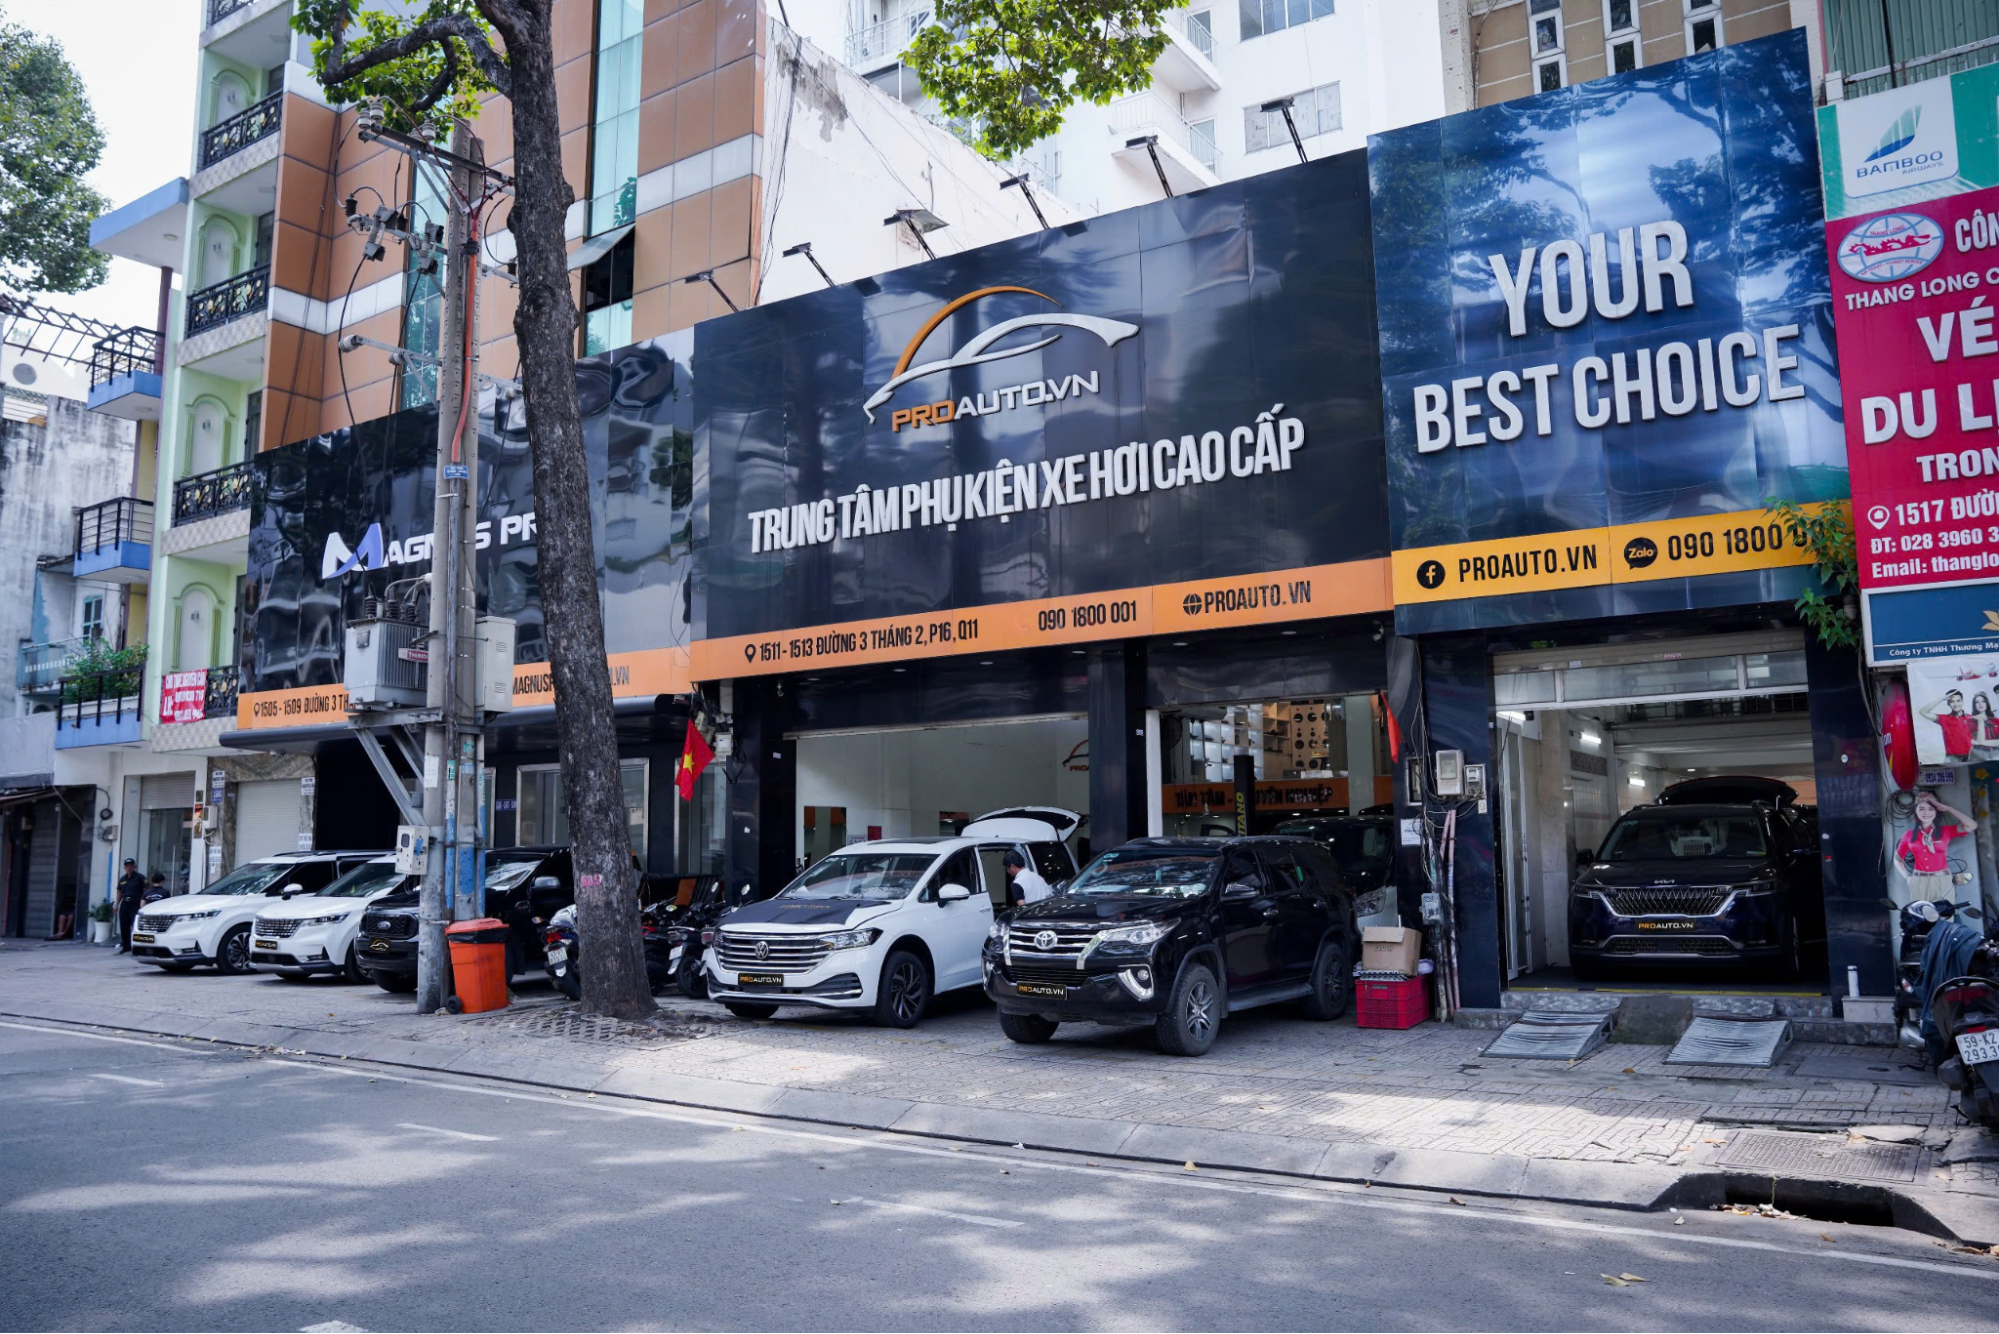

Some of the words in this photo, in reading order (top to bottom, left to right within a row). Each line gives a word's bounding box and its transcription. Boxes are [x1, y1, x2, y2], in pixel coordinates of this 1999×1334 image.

[1856, 150, 1943, 179] BAMBOO
[1902, 161, 1944, 175] AIRWAYS
[1488, 219, 1694, 338] YOUR
[1845, 284, 1914, 310] THANG
[1921, 271, 1980, 298] LONG
[1916, 295, 1998, 363] VÉ
[891, 370, 1099, 433] PROAUTO.VN
[1413, 363, 1559, 454] BEST
[1571, 323, 1806, 429] CHOICE
[1860, 388, 1938, 445] DU
[748, 498, 835, 554] TRUNG
[837, 483, 900, 539] TÂM
[902, 475, 962, 532] PHỤ
[964, 458, 1038, 523] KIỆN
[1040, 453, 1088, 509] XE
[1089, 441, 1150, 500] HƠI
[1152, 430, 1226, 490] CAO
[1229, 402, 1305, 478] CẤP
[1895, 499, 1945, 526] 1517
[1458, 544, 1598, 583] PROAUTO.VN
[1628, 545, 1655, 559] Zalo
[1667, 531, 1715, 562] 090
[1723, 523, 1783, 556] 1800
[1870, 537, 1897, 554] ĐT:
[1901, 532, 1934, 552] 028
[1938, 528, 1983, 548] 3960
[1871, 557, 1928, 579] Email:
[1038, 608, 1066, 631] 090
[1072, 603, 1107, 628] 1800
[1110, 600, 1137, 624] 001
[1204, 580, 1311, 613] PROAUTO.VN
[816, 630, 856, 655] ĐƯỜNG
[859, 630, 868, 650] 3
[871, 624, 912, 649] THÁNG
[958, 618, 978, 640] Q11
[1889, 647, 1911, 657] Công
[1912, 648, 1921, 656] ty
[1923, 645, 1948, 654] TNHH
[1950, 643, 1983, 651] Thương
[304, 692, 330, 713] ĐƯỜNG
[332, 694, 337, 712] 3
[1638, 922, 1694, 930] PROAUTO.VN
[739, 975, 782, 984] PROAUTO.VN
[1018, 985, 1064, 996] PROAUTO.VN
[1963, 1032, 1998, 1049] 59-K2
[1964, 1045, 1999, 1062] 293.3
